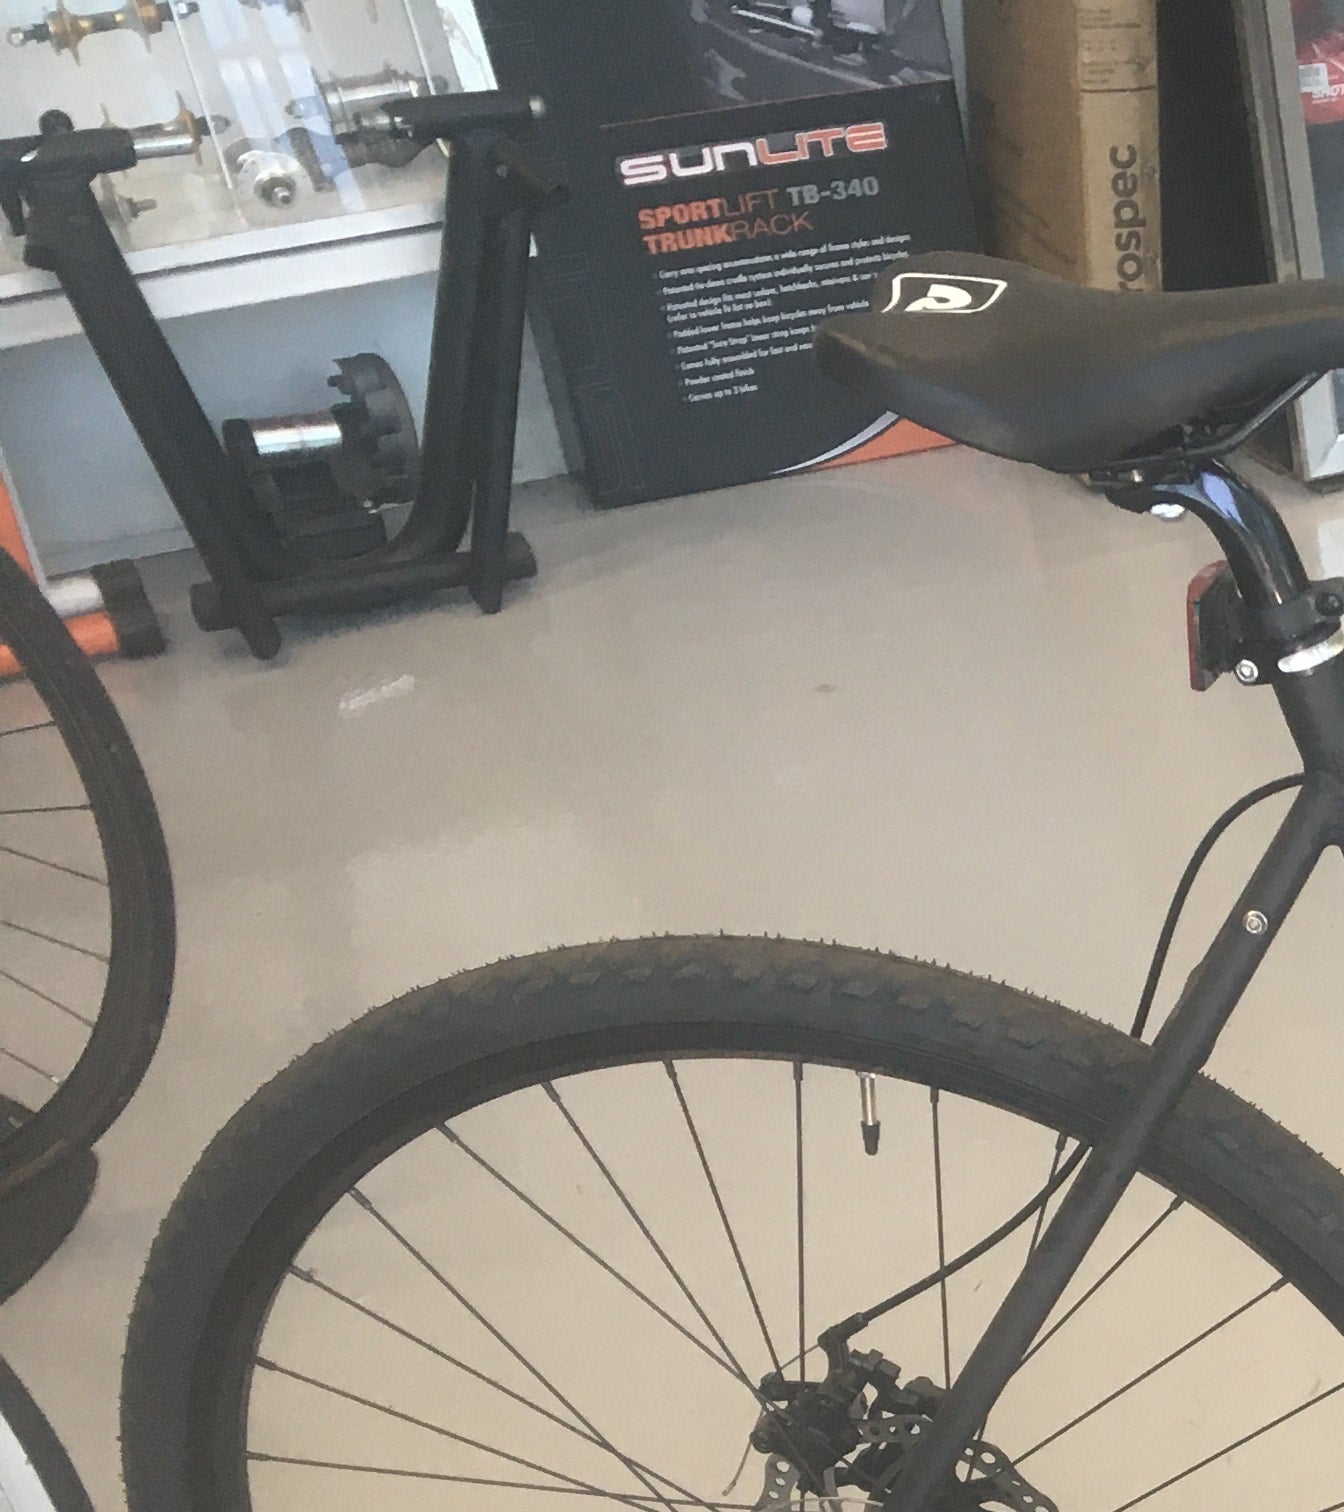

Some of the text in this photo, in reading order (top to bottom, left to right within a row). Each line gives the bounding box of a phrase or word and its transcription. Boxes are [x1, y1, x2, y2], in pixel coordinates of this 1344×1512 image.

[620, 121, 888, 186] SUNLITE
[638, 176, 879, 230] SPORTLIFT TB-340
[643, 211, 814, 255] TRUNKRACK
